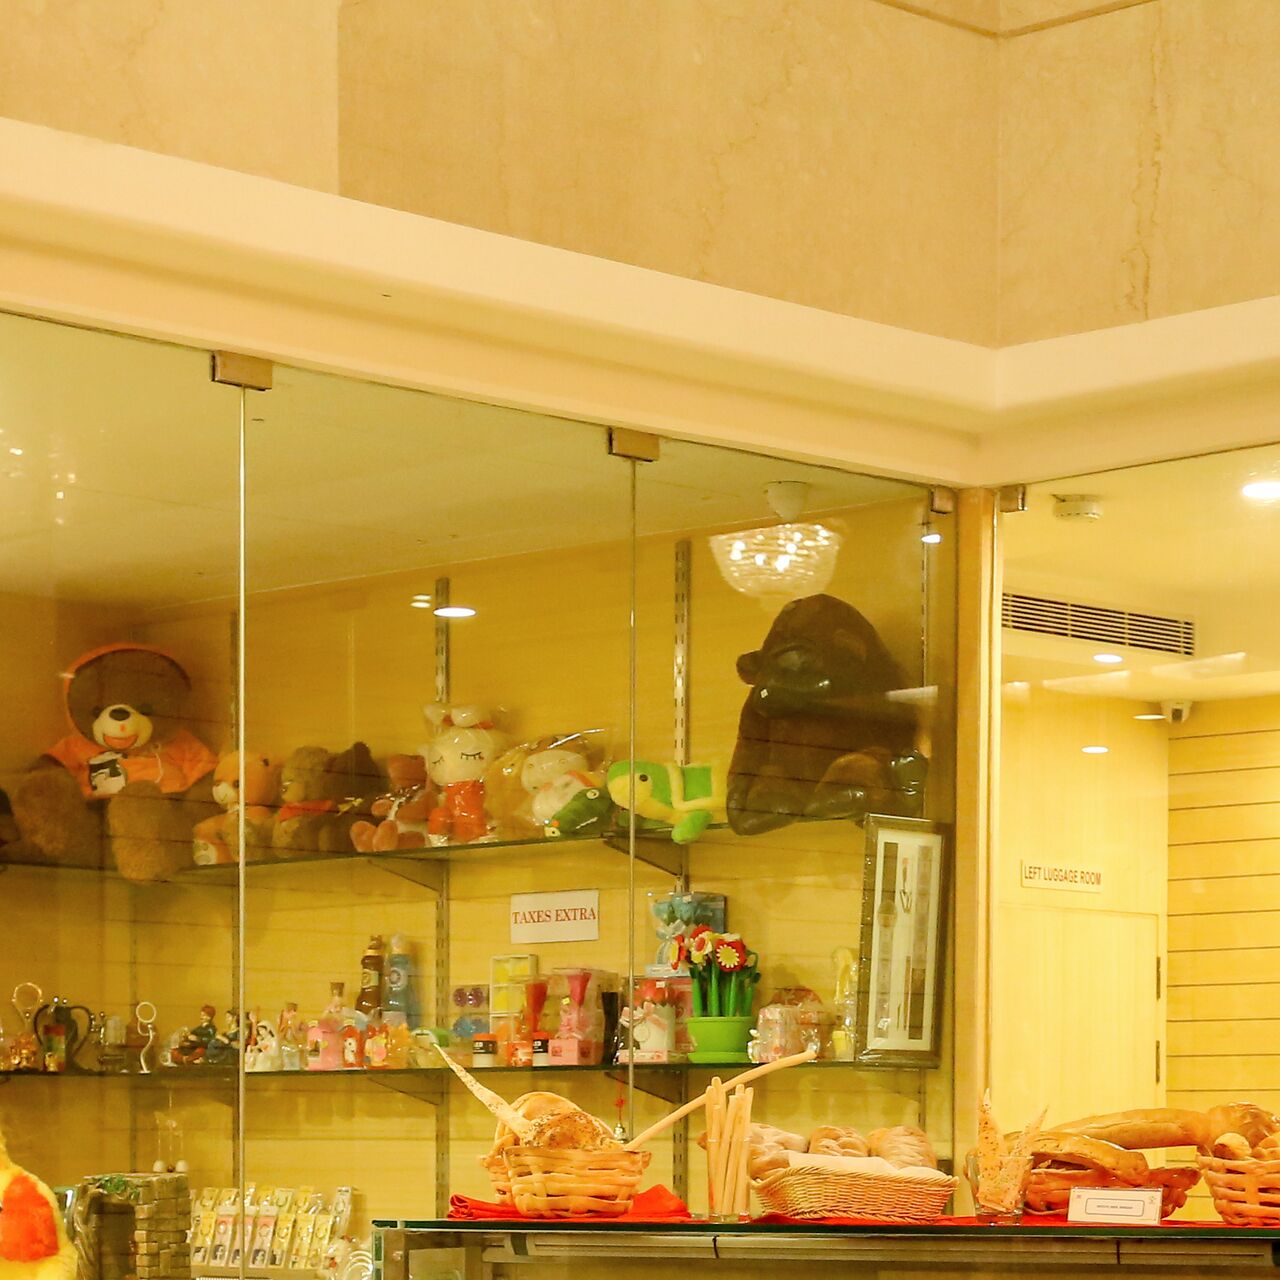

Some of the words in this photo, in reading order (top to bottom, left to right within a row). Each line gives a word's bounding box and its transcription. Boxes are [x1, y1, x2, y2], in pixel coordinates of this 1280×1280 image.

[1024, 866, 1041, 880] LEFT
[1043, 867, 1078, 884] LUGGAGE
[1080, 870, 1101, 885] ROOM
[512, 909, 552, 924] TAXES
[554, 907, 596, 922] EXTRA
